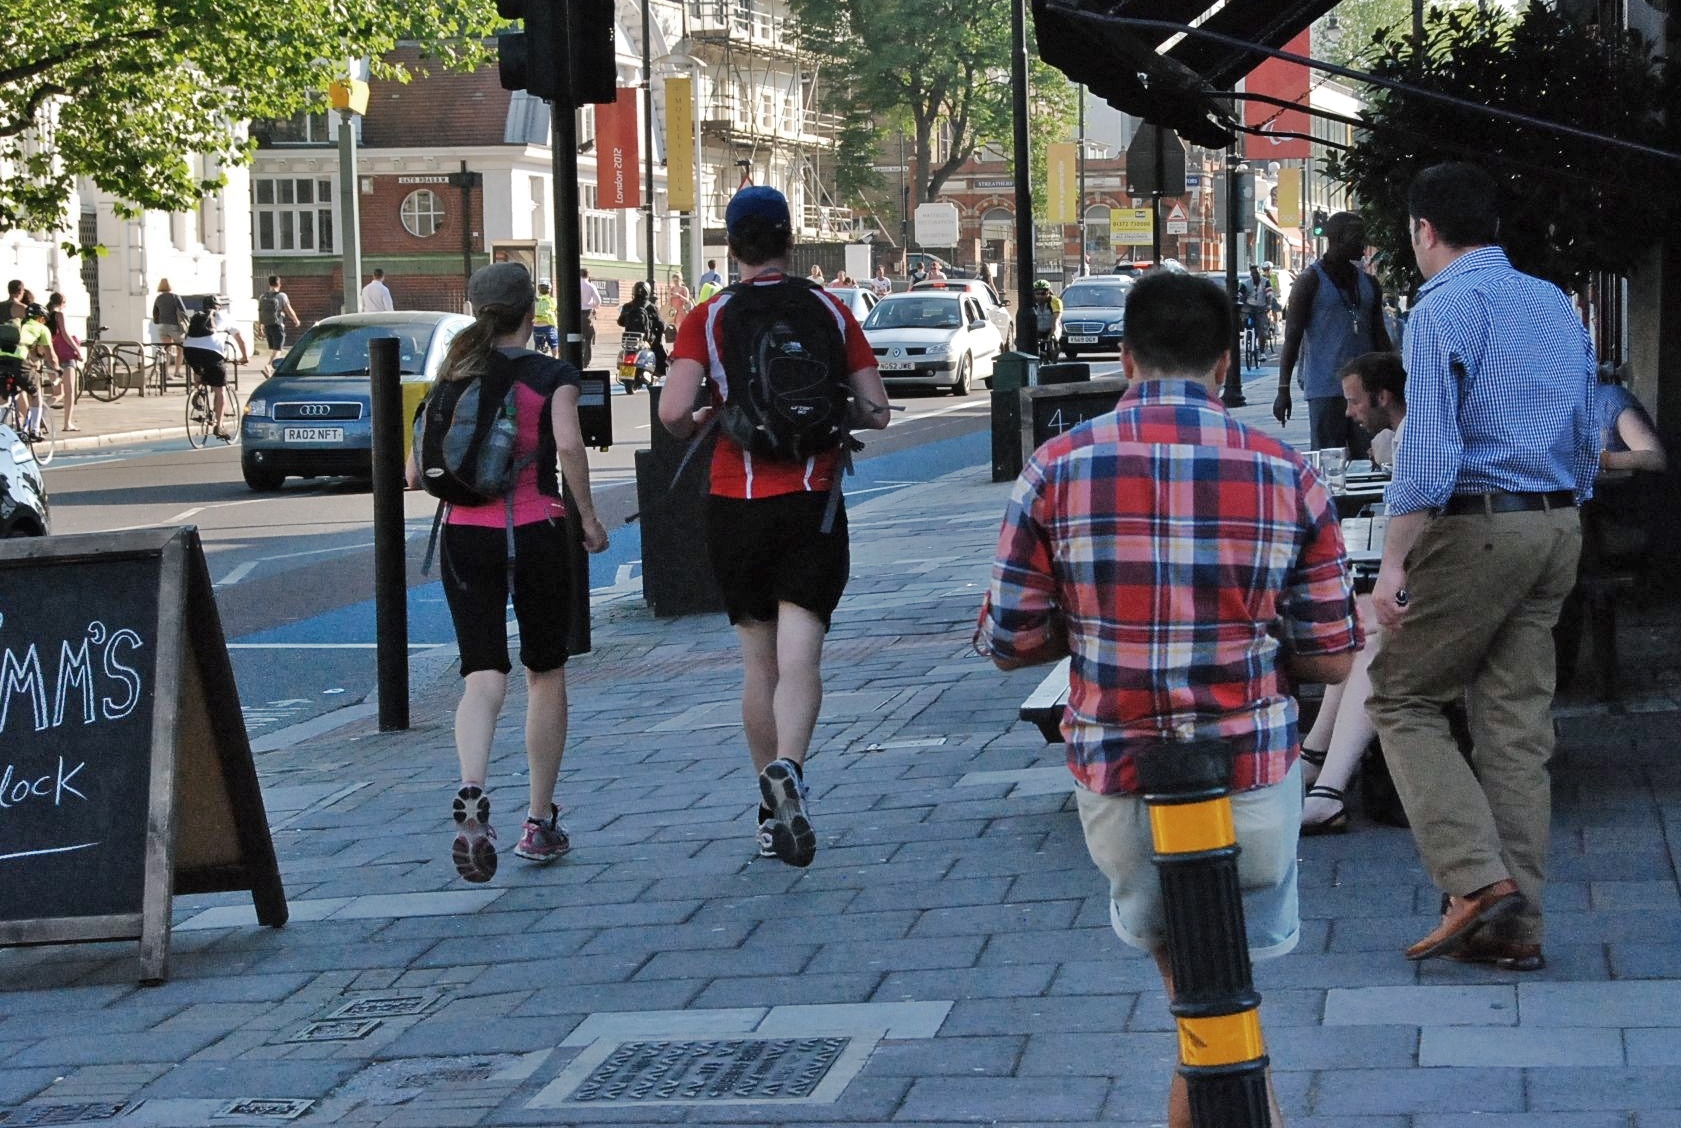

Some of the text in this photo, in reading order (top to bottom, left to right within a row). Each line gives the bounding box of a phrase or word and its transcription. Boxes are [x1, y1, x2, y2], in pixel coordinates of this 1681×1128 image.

[613, 147, 623, 204] London 2012
[289, 430, 338, 440] RA02 NFT
[1048, 408, 1071, 435] 4
